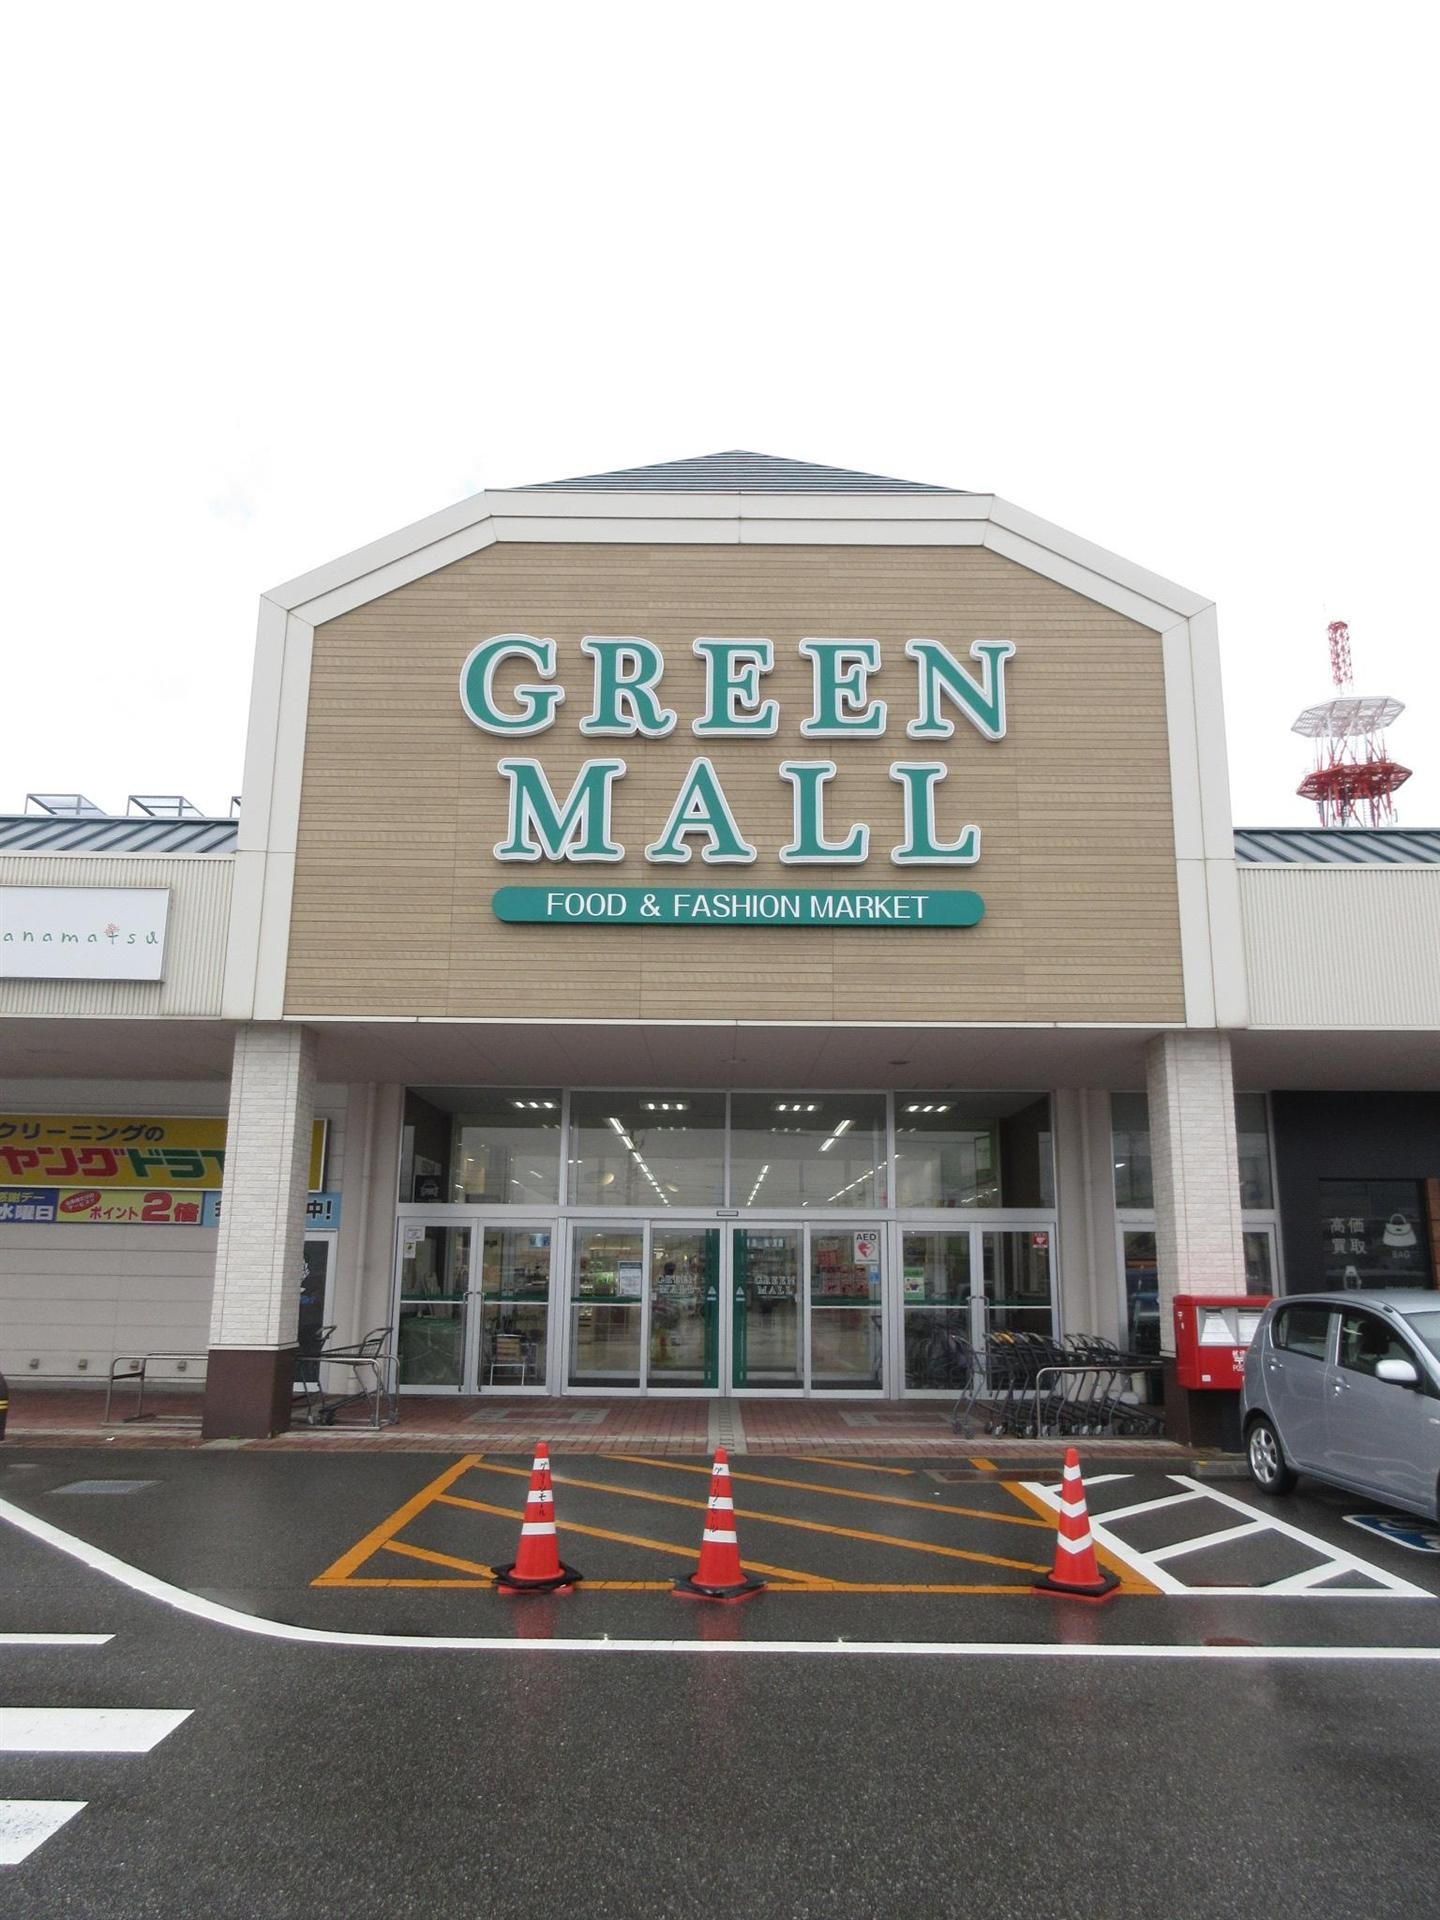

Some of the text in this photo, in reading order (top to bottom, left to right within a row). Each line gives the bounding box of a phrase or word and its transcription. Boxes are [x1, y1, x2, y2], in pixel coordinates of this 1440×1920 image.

[459, 633, 1017, 742] GREEN
[493, 757, 982, 866] MALL
[546, 892, 929, 920] FOOD & FASHION MARKET
[0, 1122, 165, 1142] クリーニングの
[856, 1233, 877, 1241] AED
